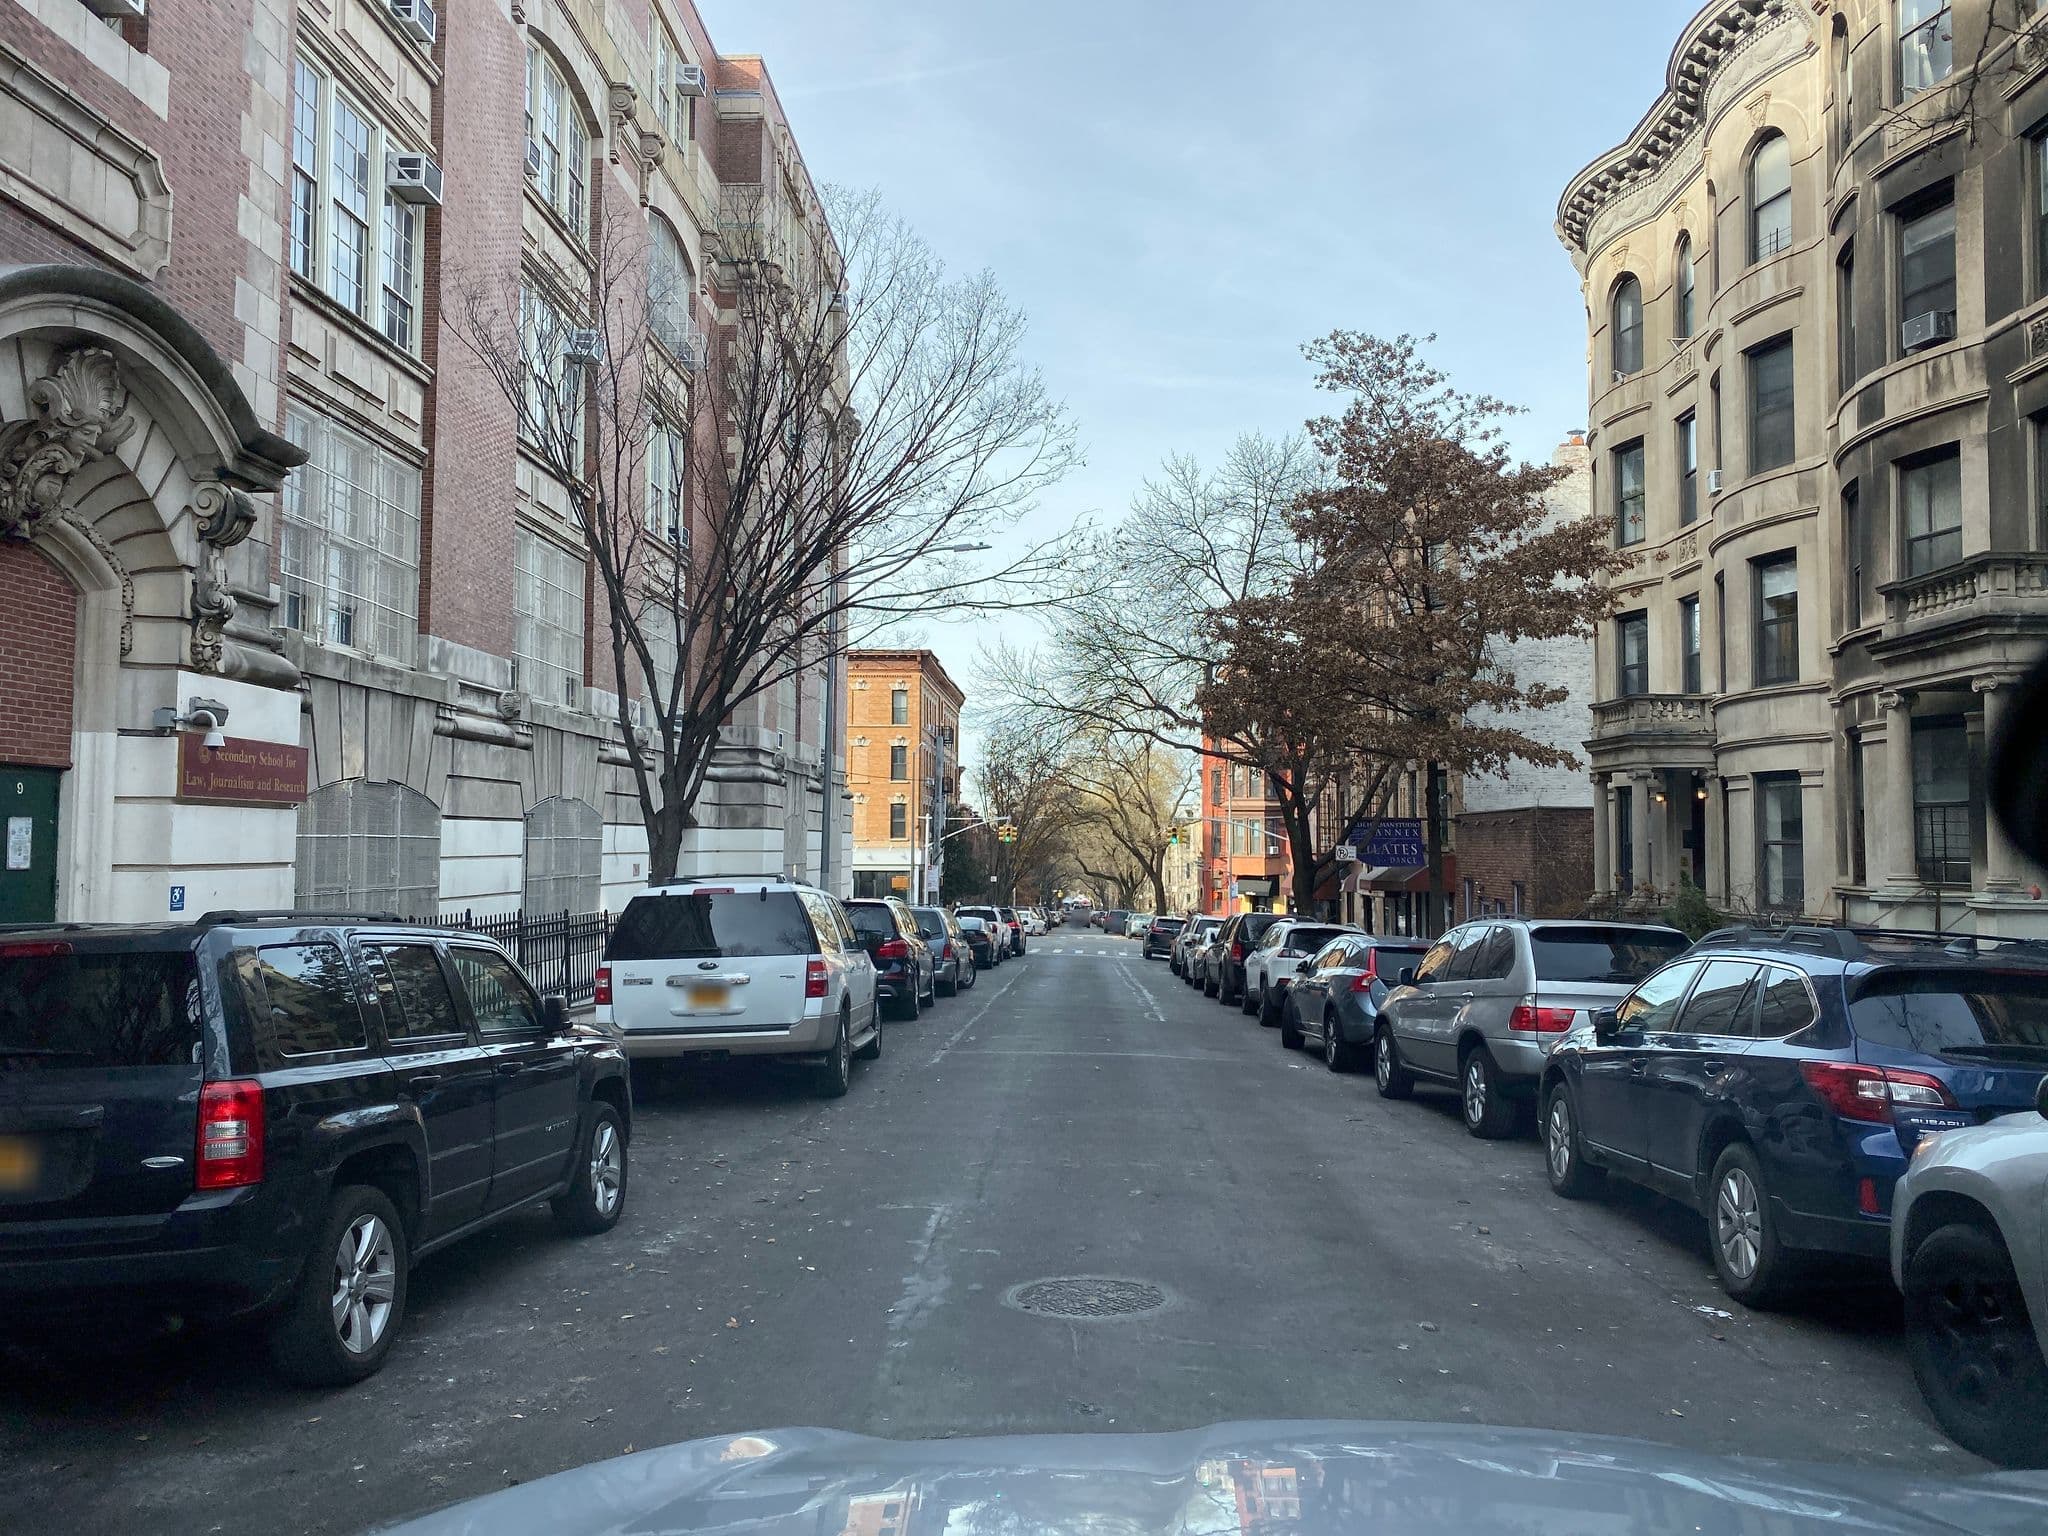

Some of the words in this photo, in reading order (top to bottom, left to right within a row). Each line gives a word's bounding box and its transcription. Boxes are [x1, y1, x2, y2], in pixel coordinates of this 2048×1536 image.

[216, 749, 257, 768] Secondary
[259, 751, 283, 767] School
[285, 755, 297, 769] for
[16, 782, 24, 794] 9
[185, 771, 206, 787] Law,
[208, 772, 255, 791] Journalism
[257, 777, 271, 791] and
[274, 778, 305, 793] Research
[1375, 828, 1420, 837] ANNEX
[1910, 1118, 1966, 1127] SUBARU
